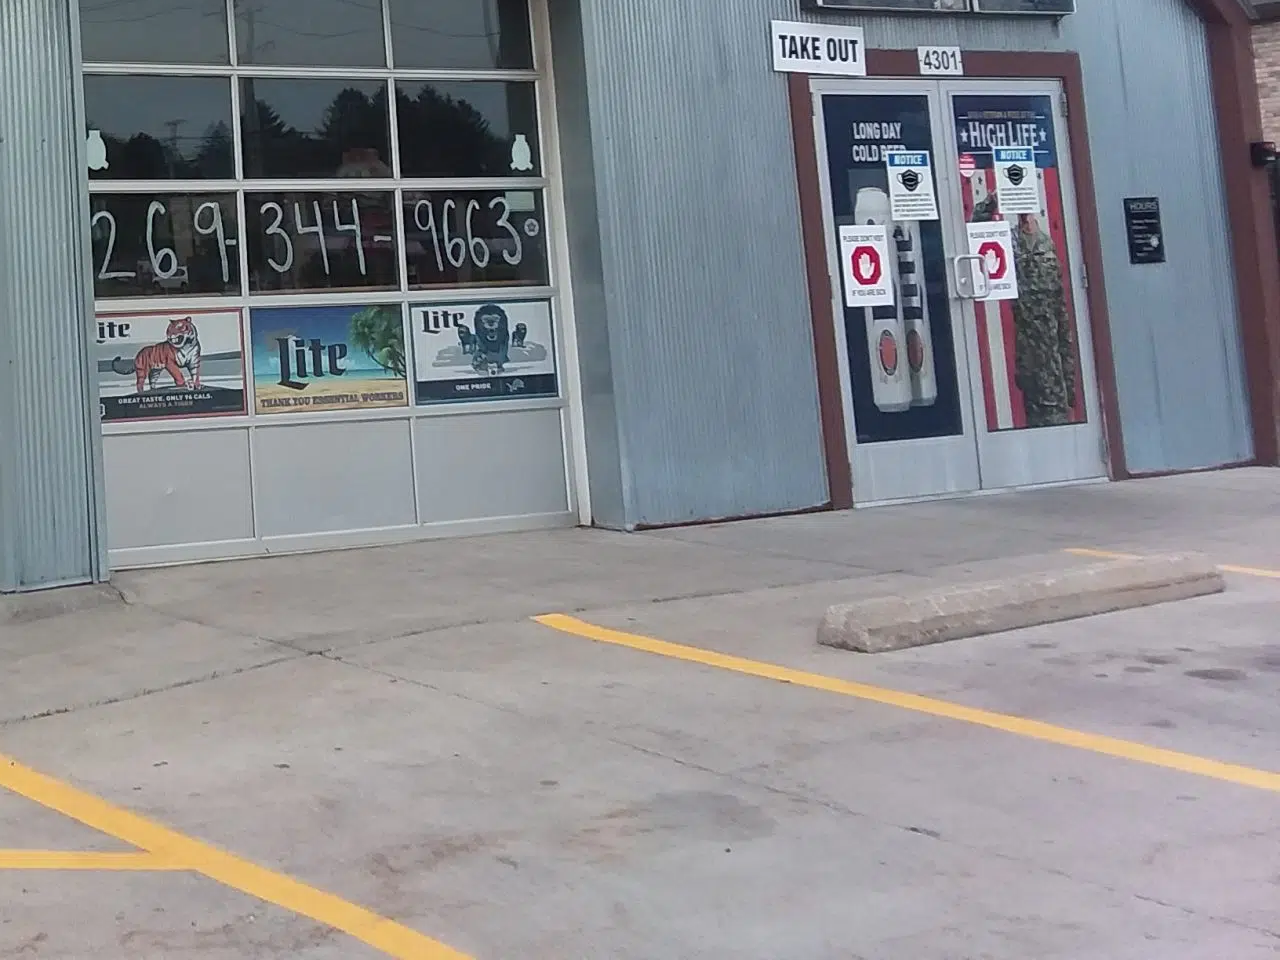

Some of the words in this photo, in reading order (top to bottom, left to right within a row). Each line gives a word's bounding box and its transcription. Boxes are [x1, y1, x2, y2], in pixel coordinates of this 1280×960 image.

[778, 33, 821, 60] TAKE
[826, 37, 859, 63] OUT
[923, 49, 958, 70] 4301
[852, 122, 881, 140] LONG
[881, 122, 902, 140] DAY
[968, 121, 1005, 147] HIGH
[1006, 121, 1039, 147] LIFE
[852, 144, 880, 162] COLD
[893, 154, 923, 165] NOTICE
[999, 149, 1027, 161] NOTICE
[1130, 201, 1157, 210] HOURS
[420, 309, 465, 335] Lite
[275, 337, 348, 390] Lite
[260, 398, 292, 408] THANK
[292, 396, 311, 406] YOU
[312, 393, 360, 405] ESSENTIAL
[360, 391, 404, 403] WORKERS
